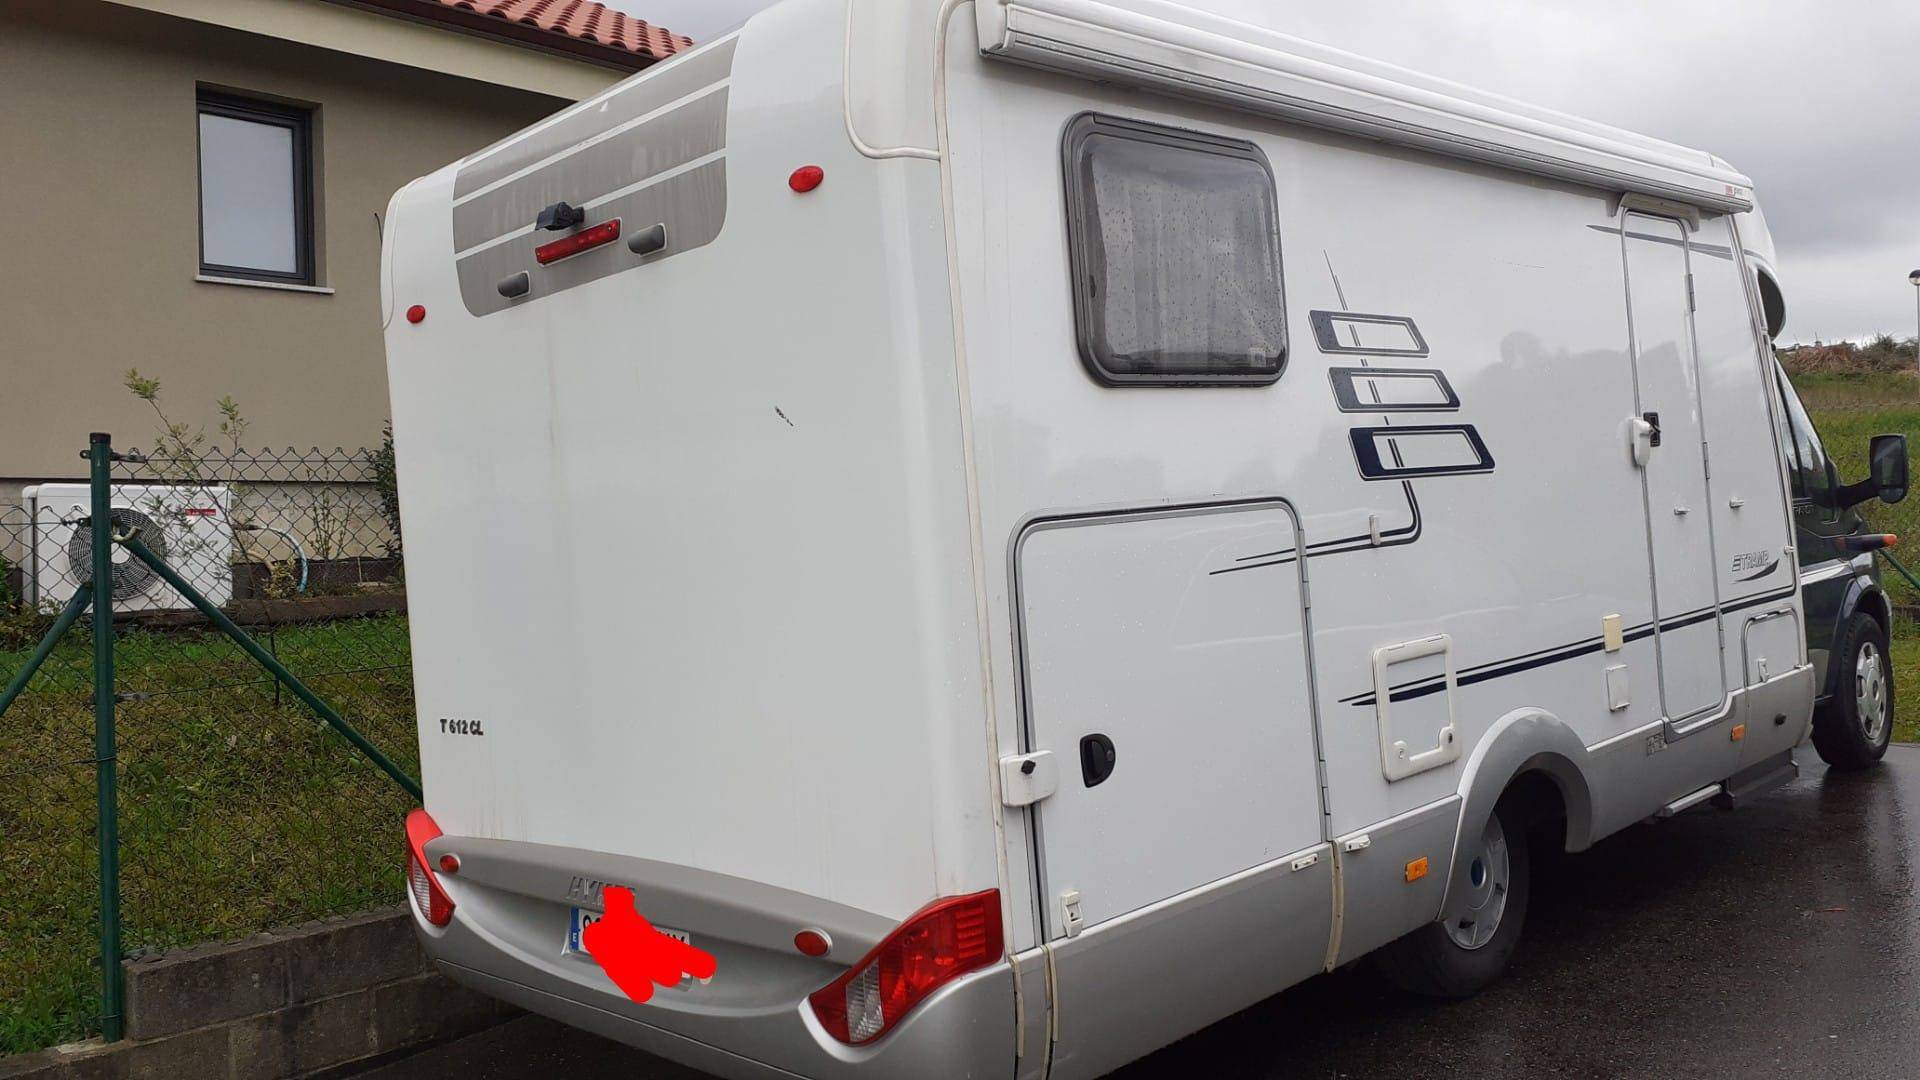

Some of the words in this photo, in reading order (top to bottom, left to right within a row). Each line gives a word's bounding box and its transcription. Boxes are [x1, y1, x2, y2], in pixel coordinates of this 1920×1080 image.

[440, 718, 448, 733] T
[449, 719, 468, 735] 612
[469, 720, 484, 736] CL
